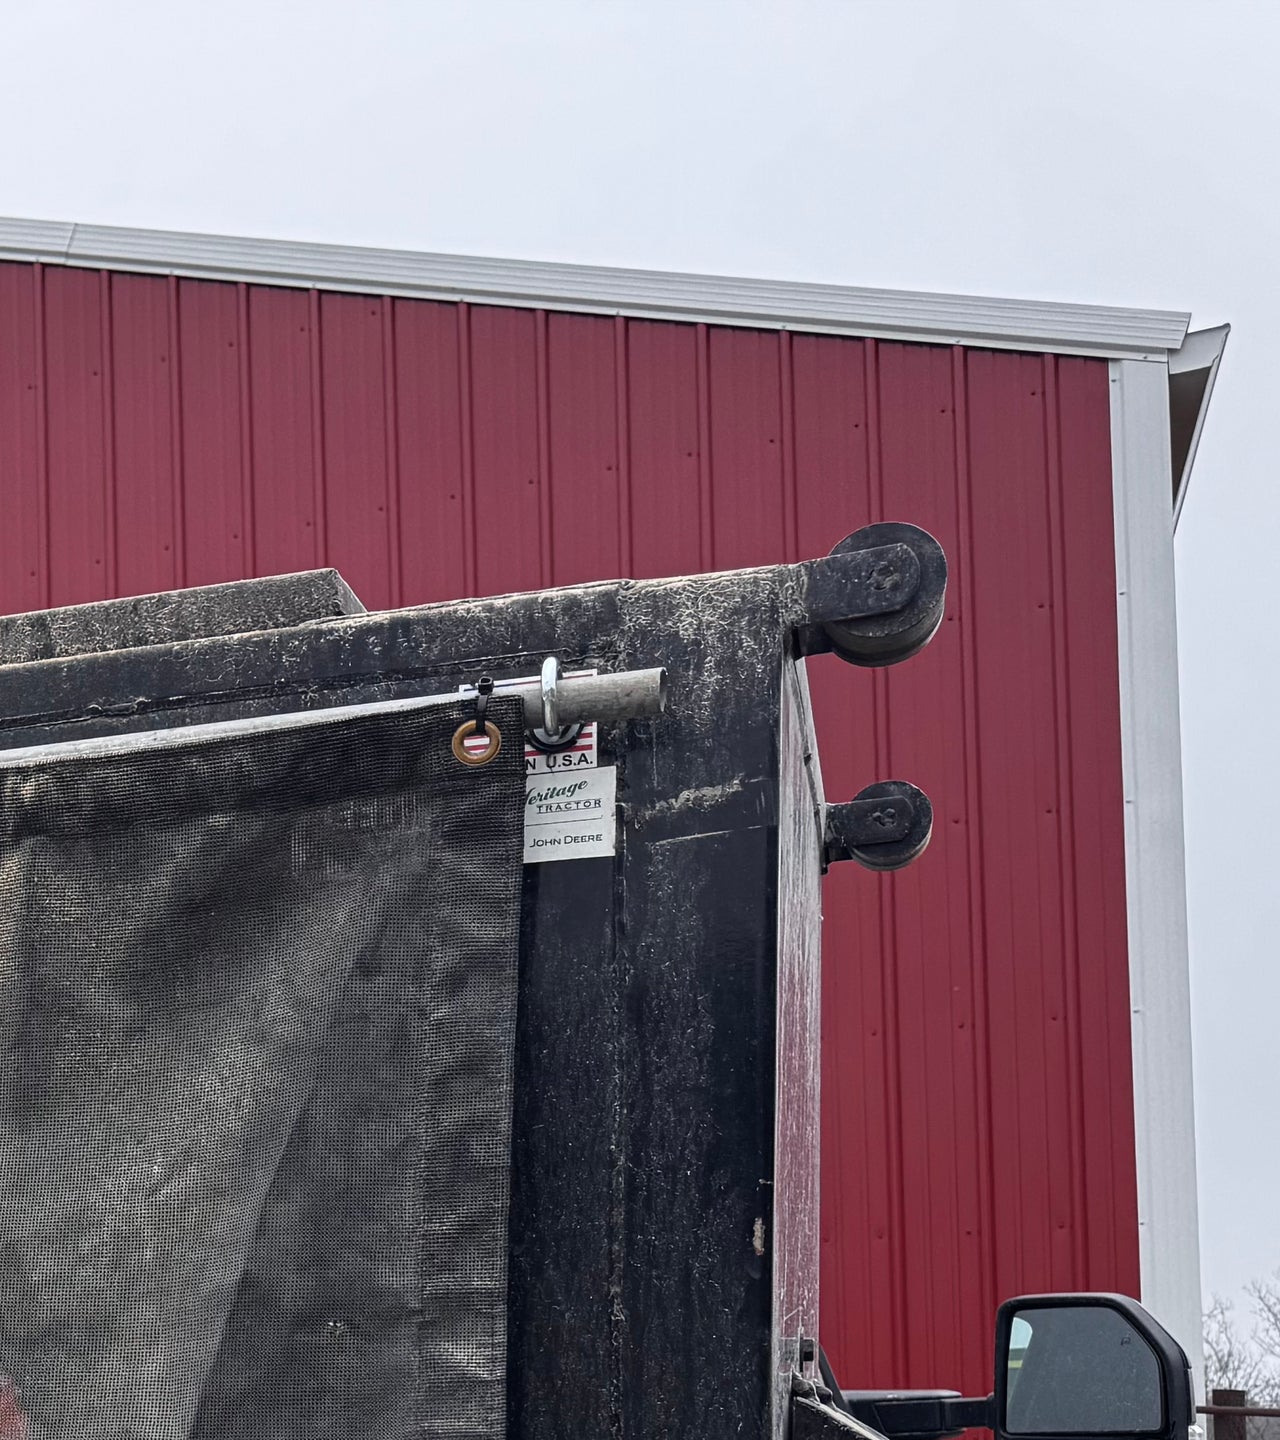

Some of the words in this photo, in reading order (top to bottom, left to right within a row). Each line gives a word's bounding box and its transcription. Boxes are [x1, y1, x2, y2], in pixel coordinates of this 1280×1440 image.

[546, 752, 593, 769] U.S.A.
[536, 798, 602, 814] TRACTOR
[529, 837, 561, 848] JOHN
[564, 833, 603, 845] DEERE
